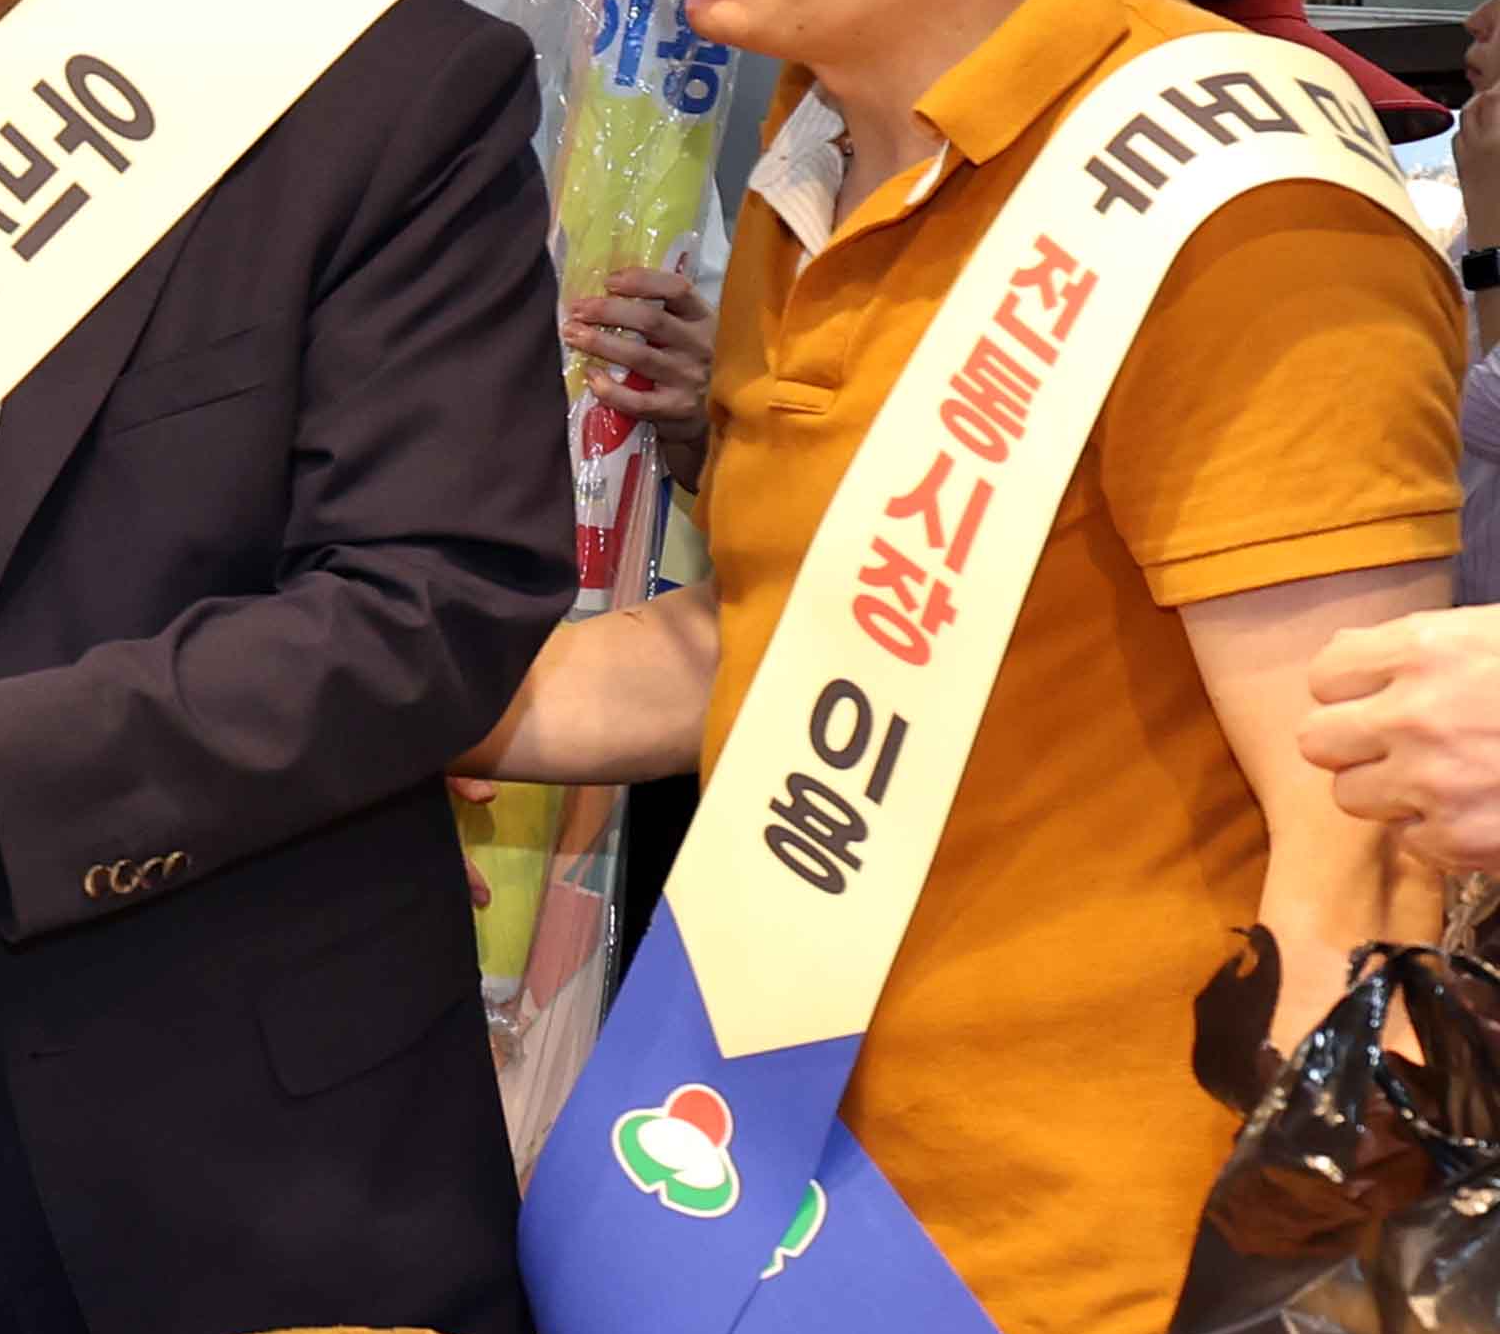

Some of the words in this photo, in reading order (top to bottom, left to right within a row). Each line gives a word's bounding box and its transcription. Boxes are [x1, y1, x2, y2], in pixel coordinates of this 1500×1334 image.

[1084, 72, 1307, 215] 모두
[852, 232, 1099, 668] 전통시장
[763, 677, 909, 895] 이용
